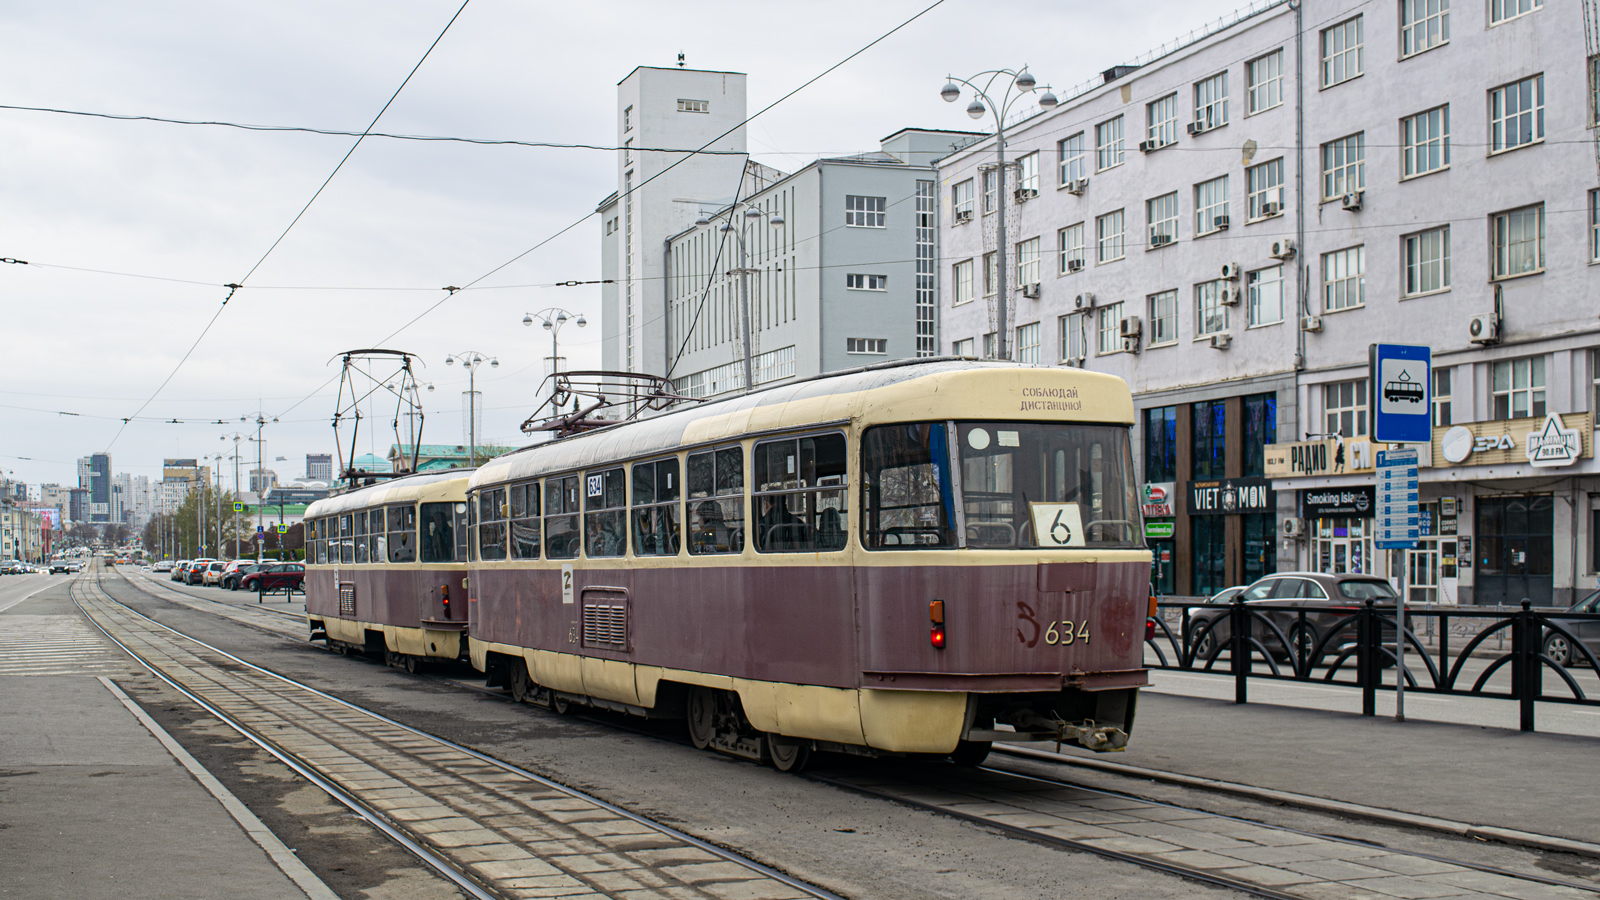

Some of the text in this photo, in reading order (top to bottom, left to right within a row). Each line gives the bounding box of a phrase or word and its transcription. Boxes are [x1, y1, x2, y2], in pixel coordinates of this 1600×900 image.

[1530, 434, 1575, 452] MAXIMUM
[1541, 447, 1564, 456] 90.8 FM
[1291, 443, 1327, 475] РАДИО
[589, 478, 601, 495] 634
[1194, 485, 1267, 510] VIET MON
[1306, 492, 1340, 506] Smoking
[1141, 504, 1171, 515] АПТЕКА
[1050, 508, 1072, 545] 6
[563, 571, 571, 590] 2
[1045, 620, 1091, 646] 634
